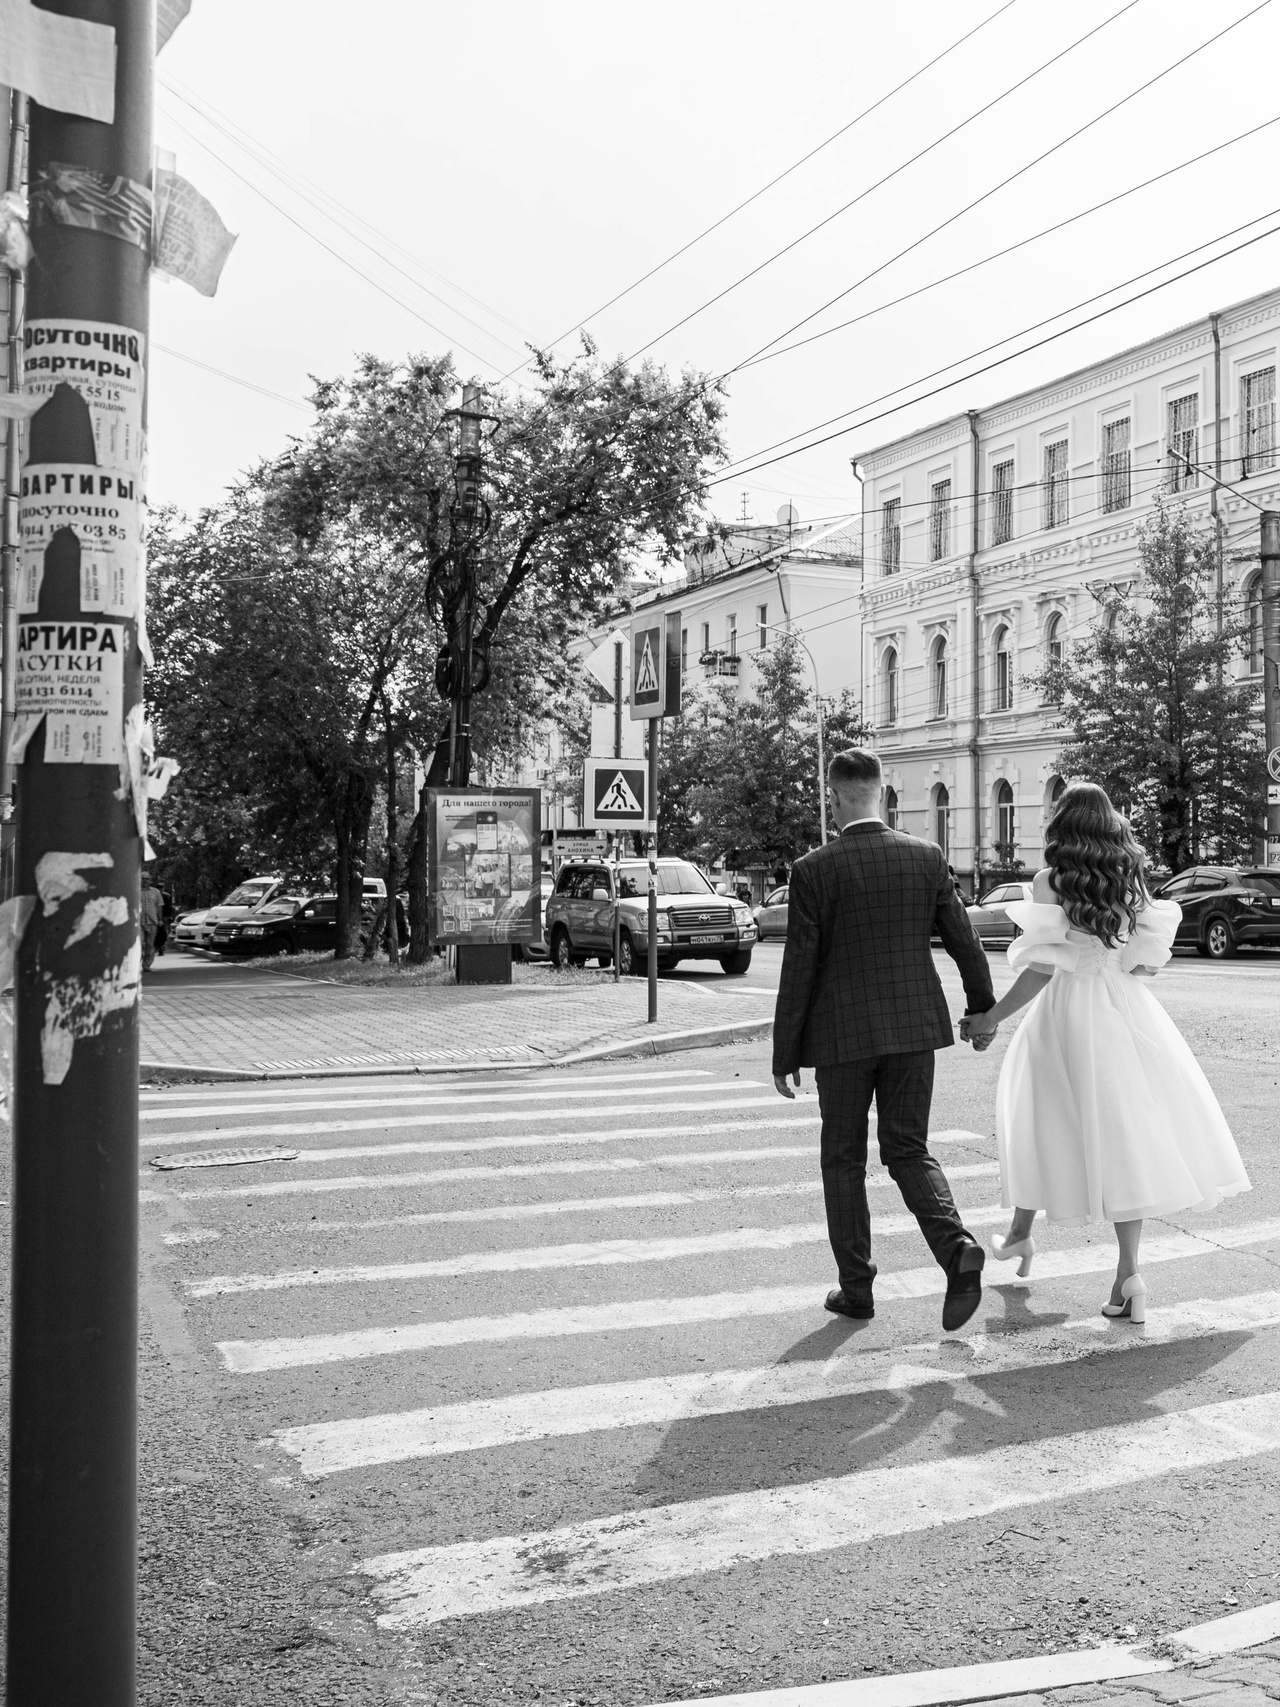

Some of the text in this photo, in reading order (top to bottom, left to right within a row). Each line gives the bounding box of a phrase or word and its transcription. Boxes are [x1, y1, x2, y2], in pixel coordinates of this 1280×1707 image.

[24, 327, 139, 362] ОСУТОЧНО
[106, 389, 120, 401] 15
[22, 473, 134, 500] ВАРТИРЫ
[83, 523, 103, 537] 03
[108, 524, 126, 540] 85
[18, 626, 118, 652] АРТИРА
[27, 654, 103, 672] СУТКИ
[57, 675, 100, 685] НЕДЕЛЯ
[60, 685, 93, 698] 6114
[442, 799, 461, 808] Для
[500, 799, 532, 808] города!
